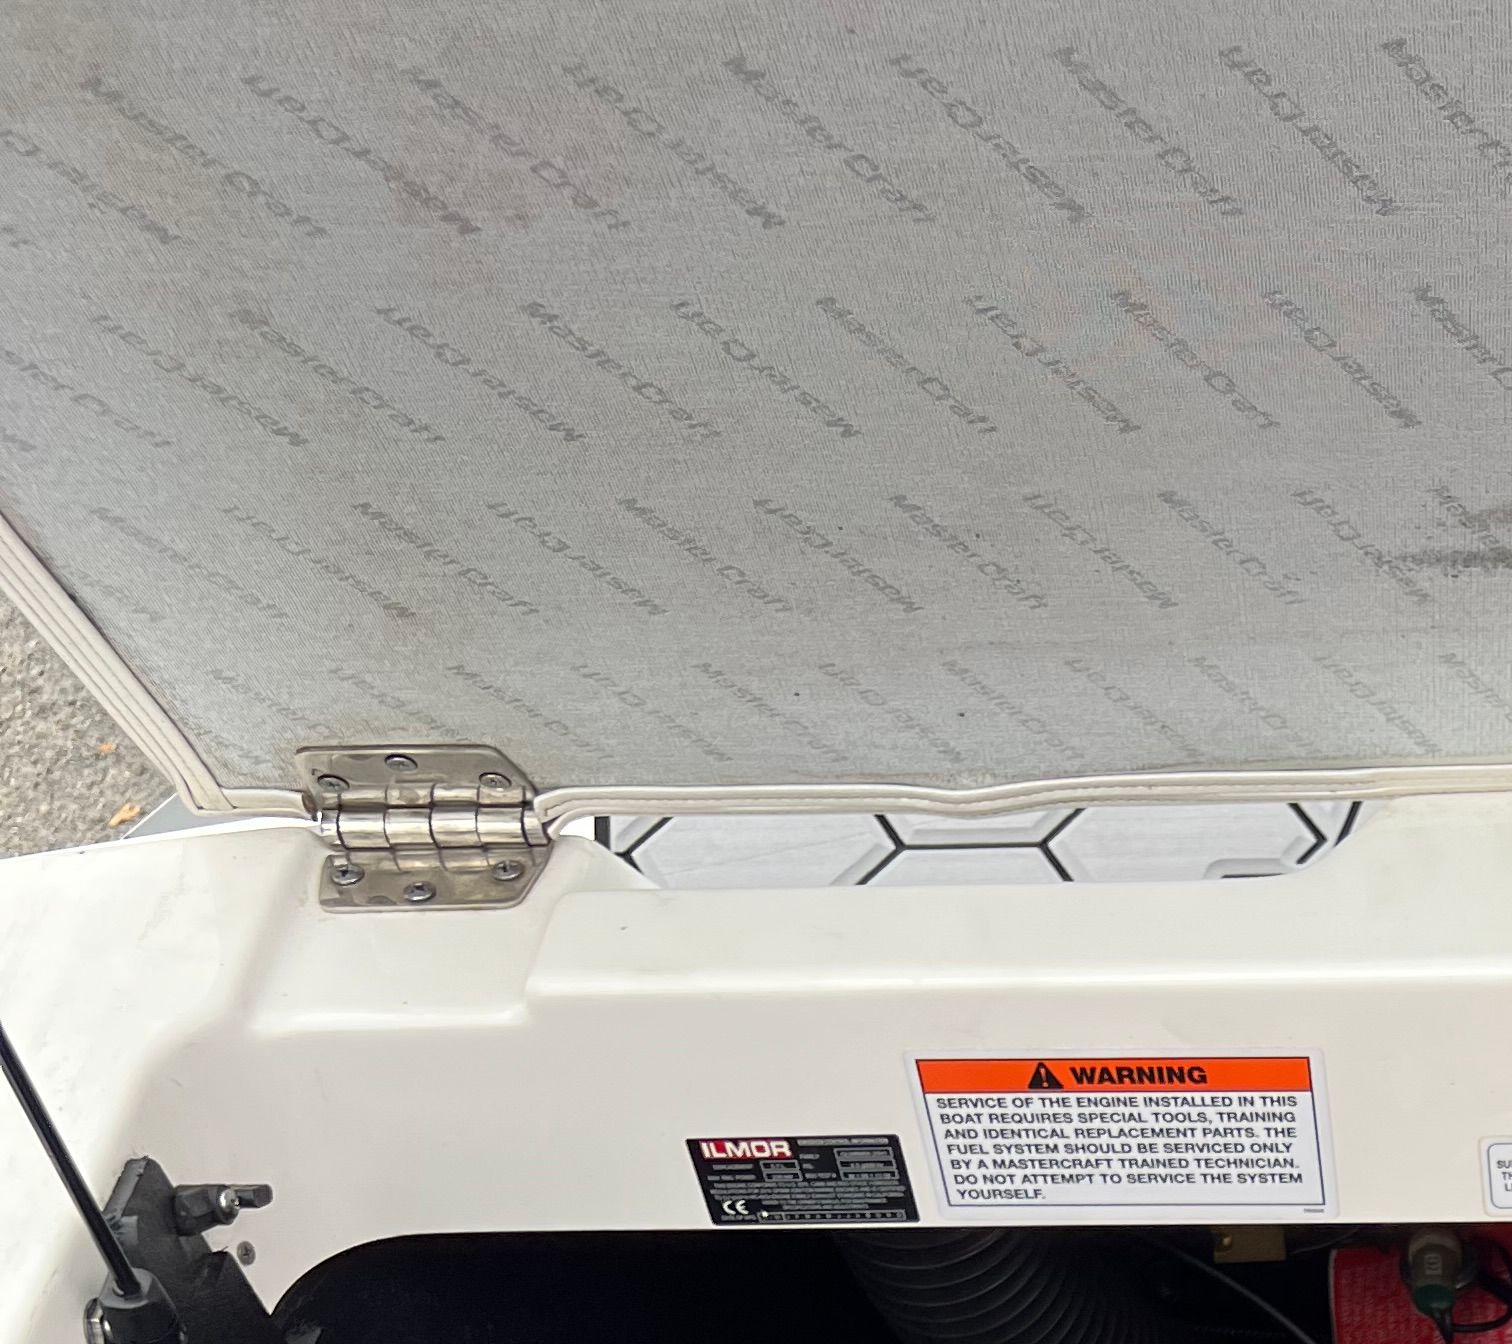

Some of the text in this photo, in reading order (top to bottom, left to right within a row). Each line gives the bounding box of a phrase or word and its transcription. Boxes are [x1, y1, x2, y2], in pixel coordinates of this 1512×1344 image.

[81, 63, 328, 237] MasterCraft
[240, 72, 481, 236] MasterCraft
[402, 66, 631, 231] MasterCraft
[562, 59, 786, 230] MasterCraft
[722, 53, 934, 225] MasterCraft
[887, 53, 1092, 225] MasterCraft
[1053, 44, 1244, 217] MasterCraft
[1219, 44, 1400, 217] MasterCraft
[91, 313, 308, 447] MasterCraft
[230, 306, 445, 444] MasterCraft
[374, 305, 586, 442] MasterCraft
[519, 301, 722, 439] MasterCraft
[669, 300, 862, 439] MasterCraft
[815, 295, 1000, 434] MasterCraft
[965, 294, 1142, 434] MasterCraft
[1106, 289, 1281, 431] MasterCraft
[1259, 287, 1422, 429] MasterCraft
[936, 1096, 1298, 1109] SERVICE OF THE ENGINE INSTALLED IN THIS
[940, 1111, 1296, 1124] BOAT REQUIRES SPECIAL TOOLS, TRAINING
[944, 1127, 1297, 1140] AND IDENTICAL REPLACEMENT PARTS. THE
[1071, 1066, 1207, 1085] WARNING
[700, 1140, 792, 1158] ILMOR
[947, 1142, 1293, 1155] FUEL SYSTEM SHOULD BE SERVICED ONLY
[951, 1157, 1299, 1170] BY A MASTERCRAFT TRAINED TECHNICIAN.
[954, 1172, 1303, 1185] DO NOT ATTEMPT TO SERVICE THE SYSTEM
[957, 1187, 1046, 1200] YOURSELF.
